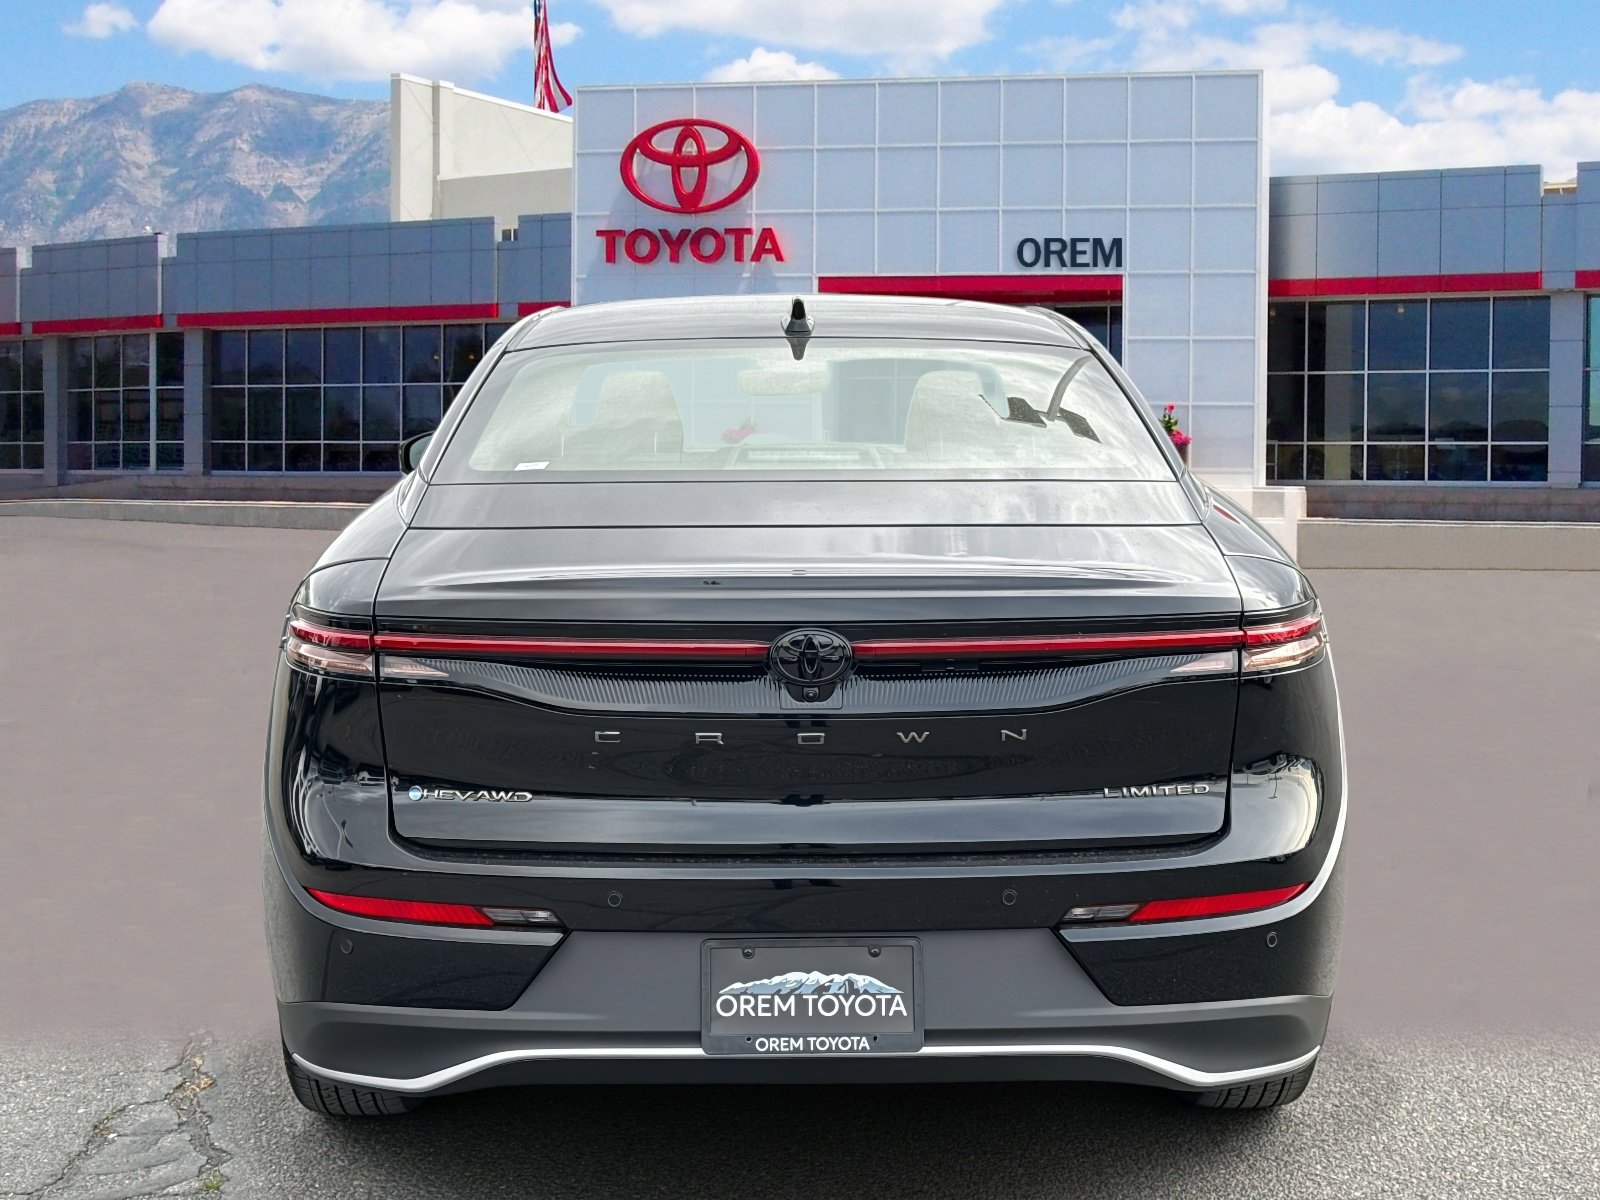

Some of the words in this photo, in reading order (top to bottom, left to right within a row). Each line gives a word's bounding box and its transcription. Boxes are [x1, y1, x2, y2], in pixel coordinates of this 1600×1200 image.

[596, 227, 784, 264] TOYOTA
[1016, 237, 1123, 268] OREM
[594, 728, 1028, 745] CROWN
[1104, 784, 1210, 799] LIMITED
[716, 994, 796, 1018] OREM
[802, 994, 908, 1018] TOYOTA
[755, 1036, 804, 1052] OREM
[807, 1036, 871, 1051] TOYOTA
